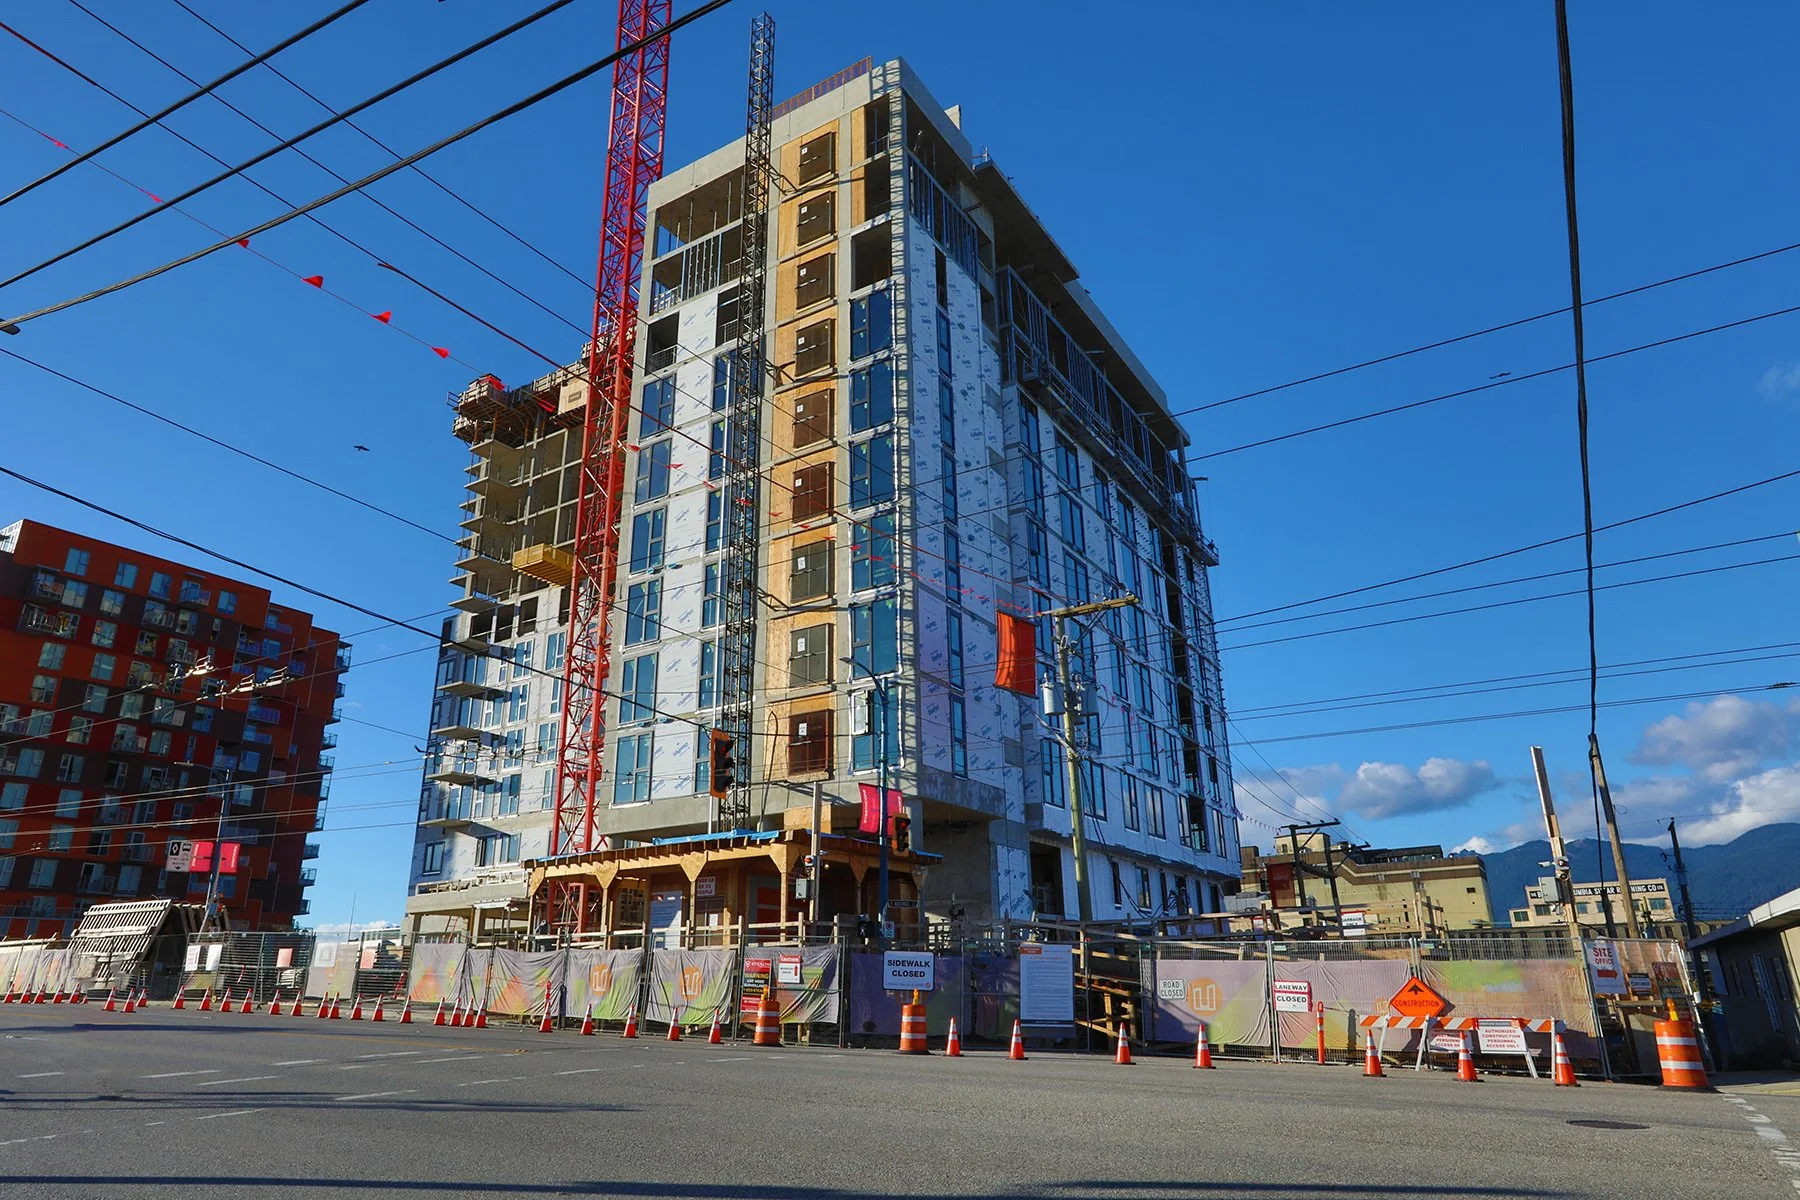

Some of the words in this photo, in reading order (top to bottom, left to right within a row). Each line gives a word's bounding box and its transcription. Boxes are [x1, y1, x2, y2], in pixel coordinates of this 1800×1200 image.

[1593, 947, 1613, 957] SITE
[887, 959, 930, 967] SIDEWALK
[892, 969, 925, 977] CLOSED
[1276, 995, 1307, 1003] CLOSED
[1394, 999, 1440, 1008] CONSTRUCTION
